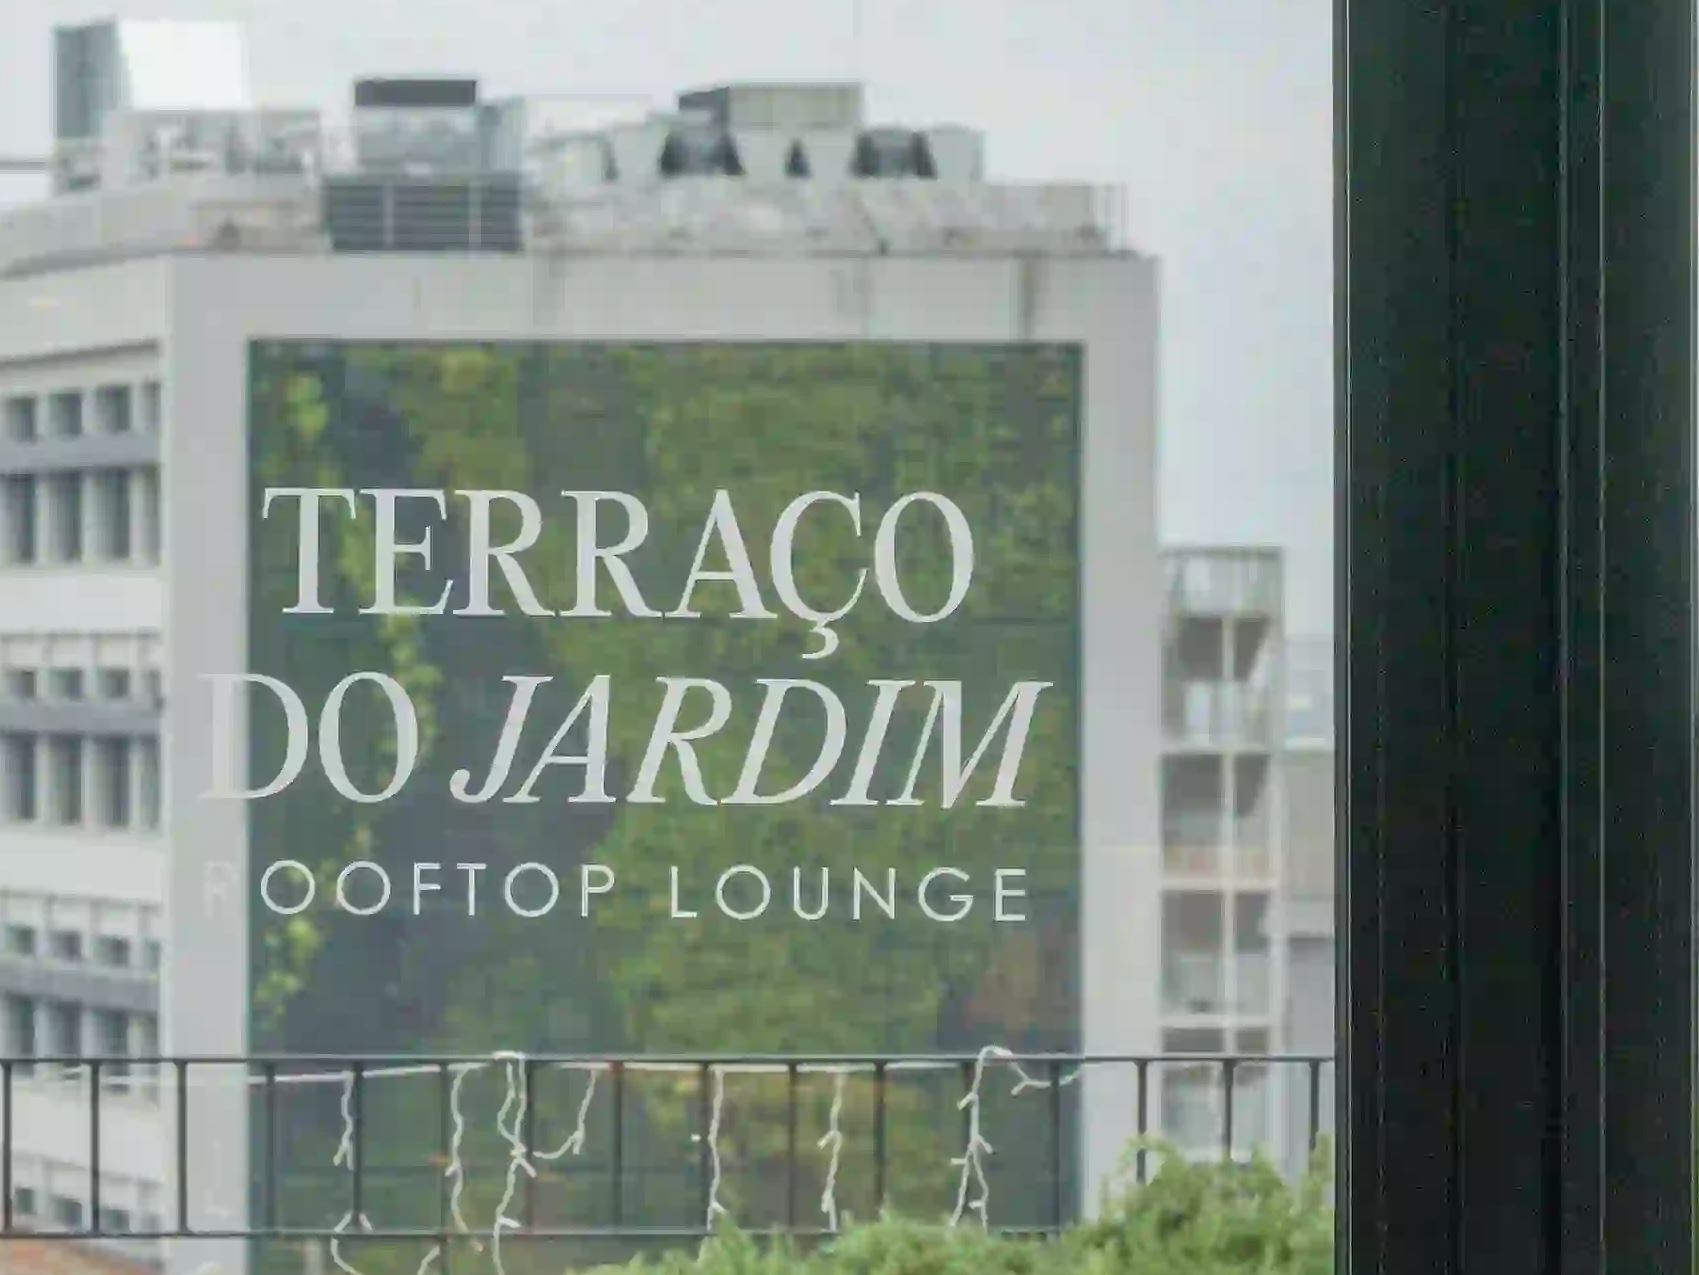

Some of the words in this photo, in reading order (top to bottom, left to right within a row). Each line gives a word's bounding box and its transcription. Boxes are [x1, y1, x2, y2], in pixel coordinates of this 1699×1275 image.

[261, 486, 975, 660] TERRAÇO
[197, 670, 419, 804] DO
[449, 674, 1054, 809] JARDIM
[670, 864, 1029, 922] LOUNGE
